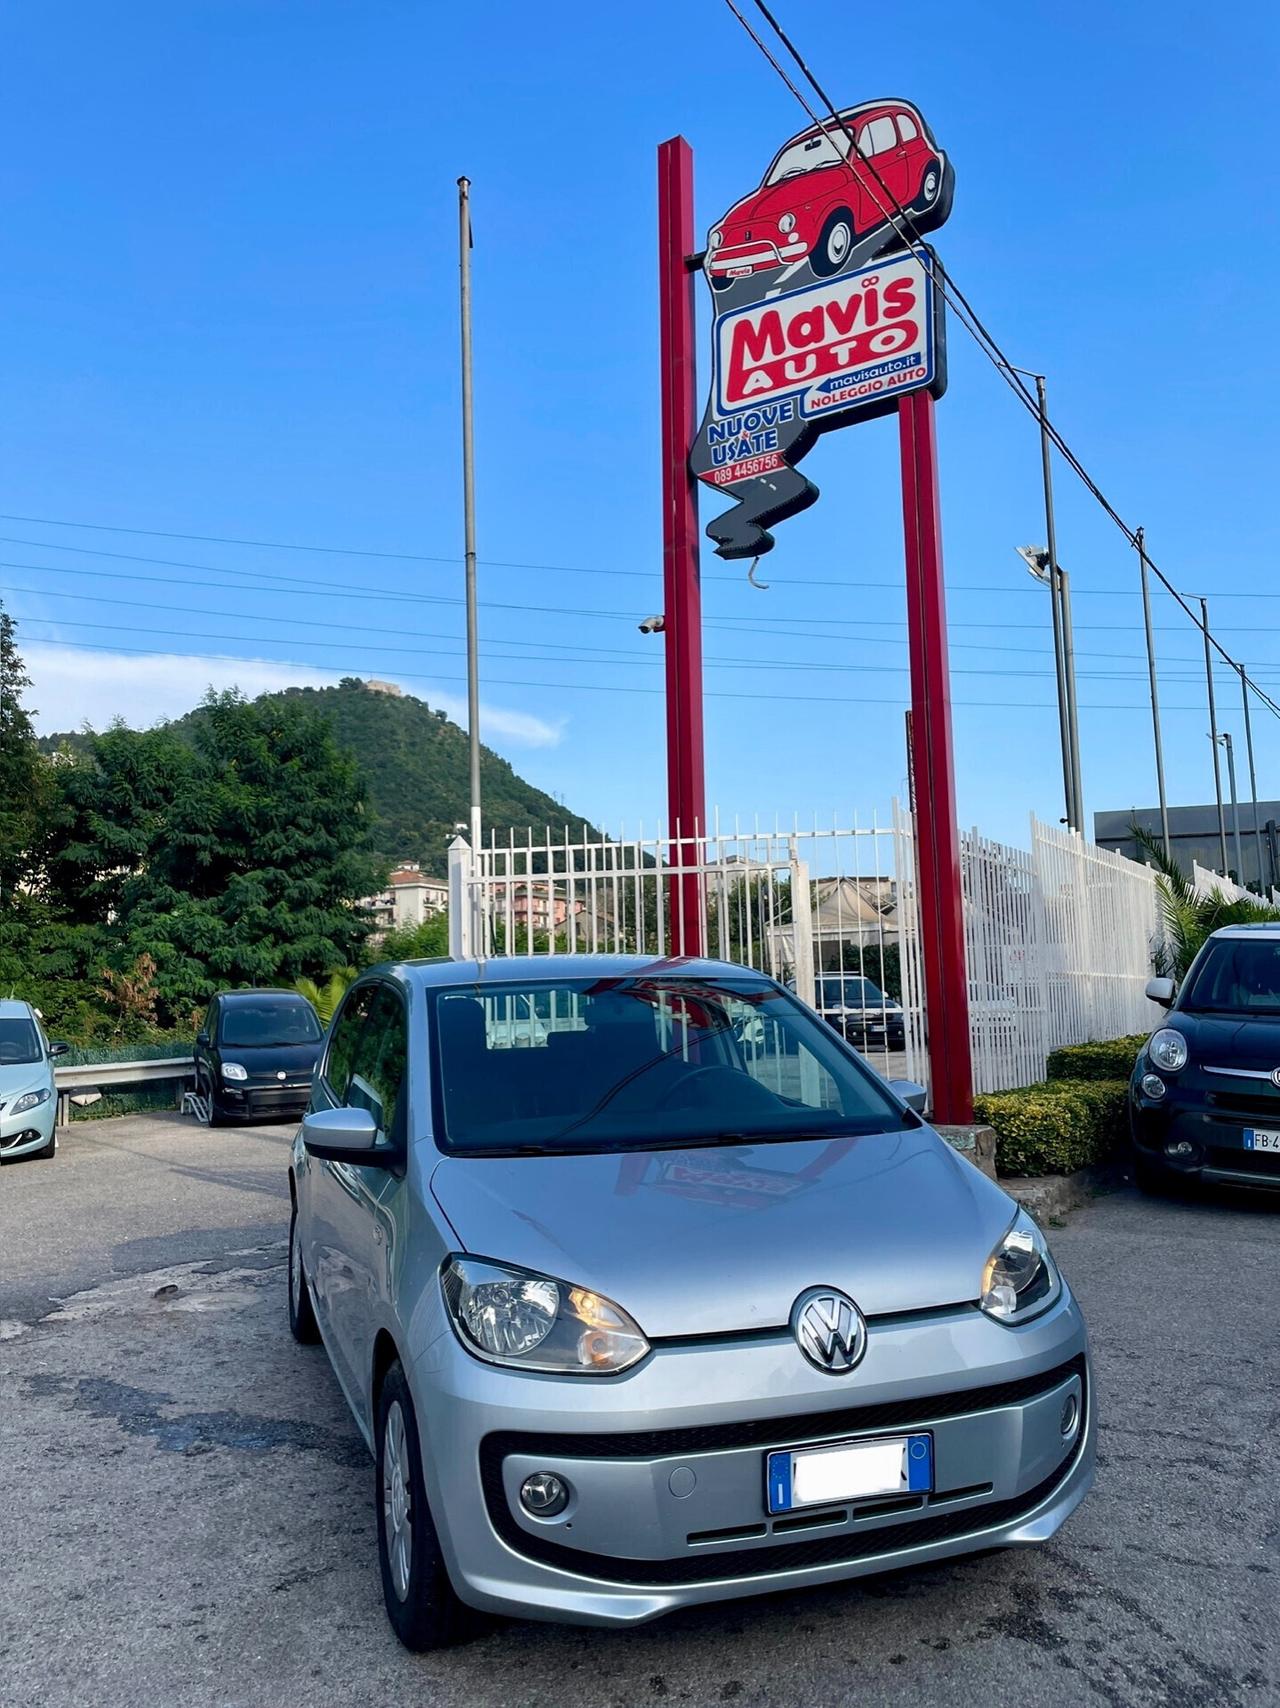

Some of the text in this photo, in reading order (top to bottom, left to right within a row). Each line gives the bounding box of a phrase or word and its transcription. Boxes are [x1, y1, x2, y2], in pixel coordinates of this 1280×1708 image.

[742, 328, 908, 395] AUTO
[830, 355, 916, 390] mavisauto.it
[811, 367, 926, 409] NOLEGGIO AUTO
[708, 400, 793, 444] NUOVE
[712, 428, 777, 465] USATE
[714, 454, 778, 484] 089 4456756
